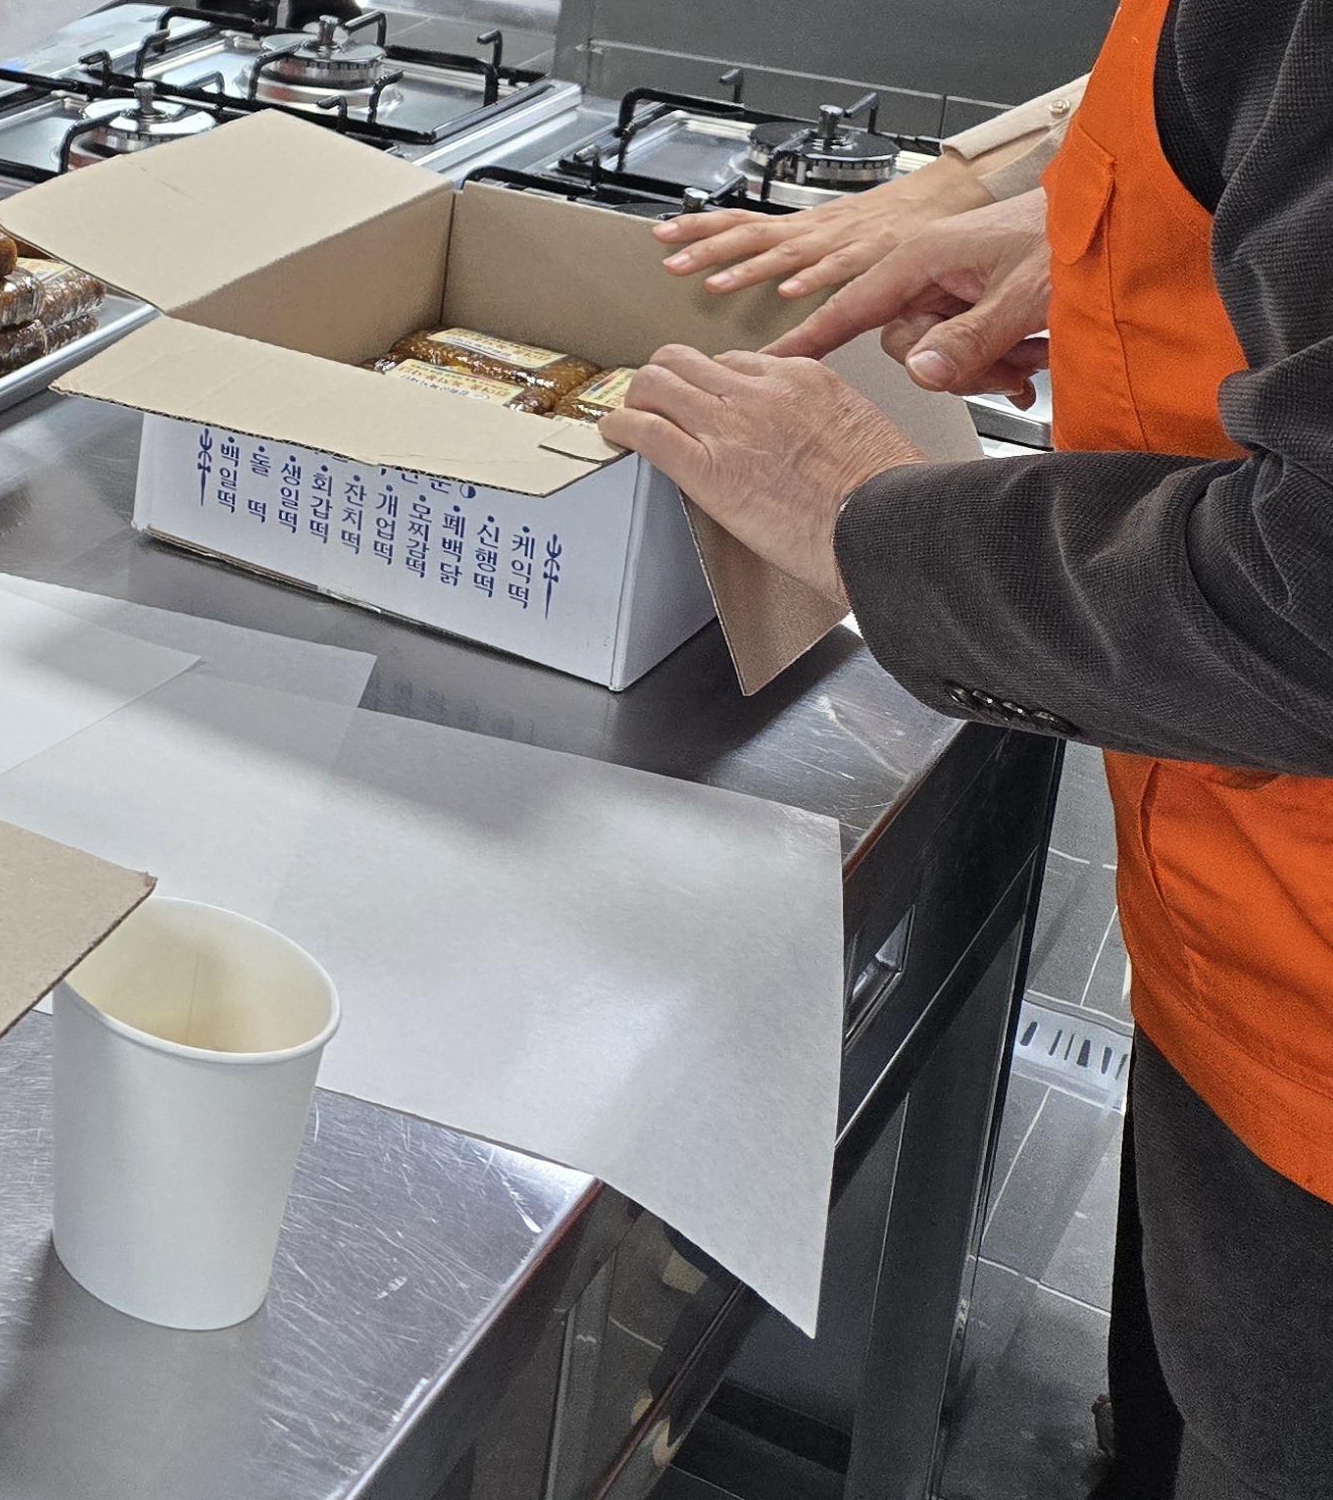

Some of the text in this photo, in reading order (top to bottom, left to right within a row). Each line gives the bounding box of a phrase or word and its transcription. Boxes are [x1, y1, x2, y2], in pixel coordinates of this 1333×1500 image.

[217, 443, 240, 513] 백일떡
[278, 462, 301, 533] 생일떡
[310, 472, 333, 543] 회갑떡
[341, 482, 367, 554] 잔치떡
[373, 492, 398, 565] 개업떡
[406, 503, 432, 578] 모찌감떡
[440, 513, 465, 586] 폐백닭
[474, 524, 500, 597] 신행떡
[508, 534, 535, 609] 케익떡
